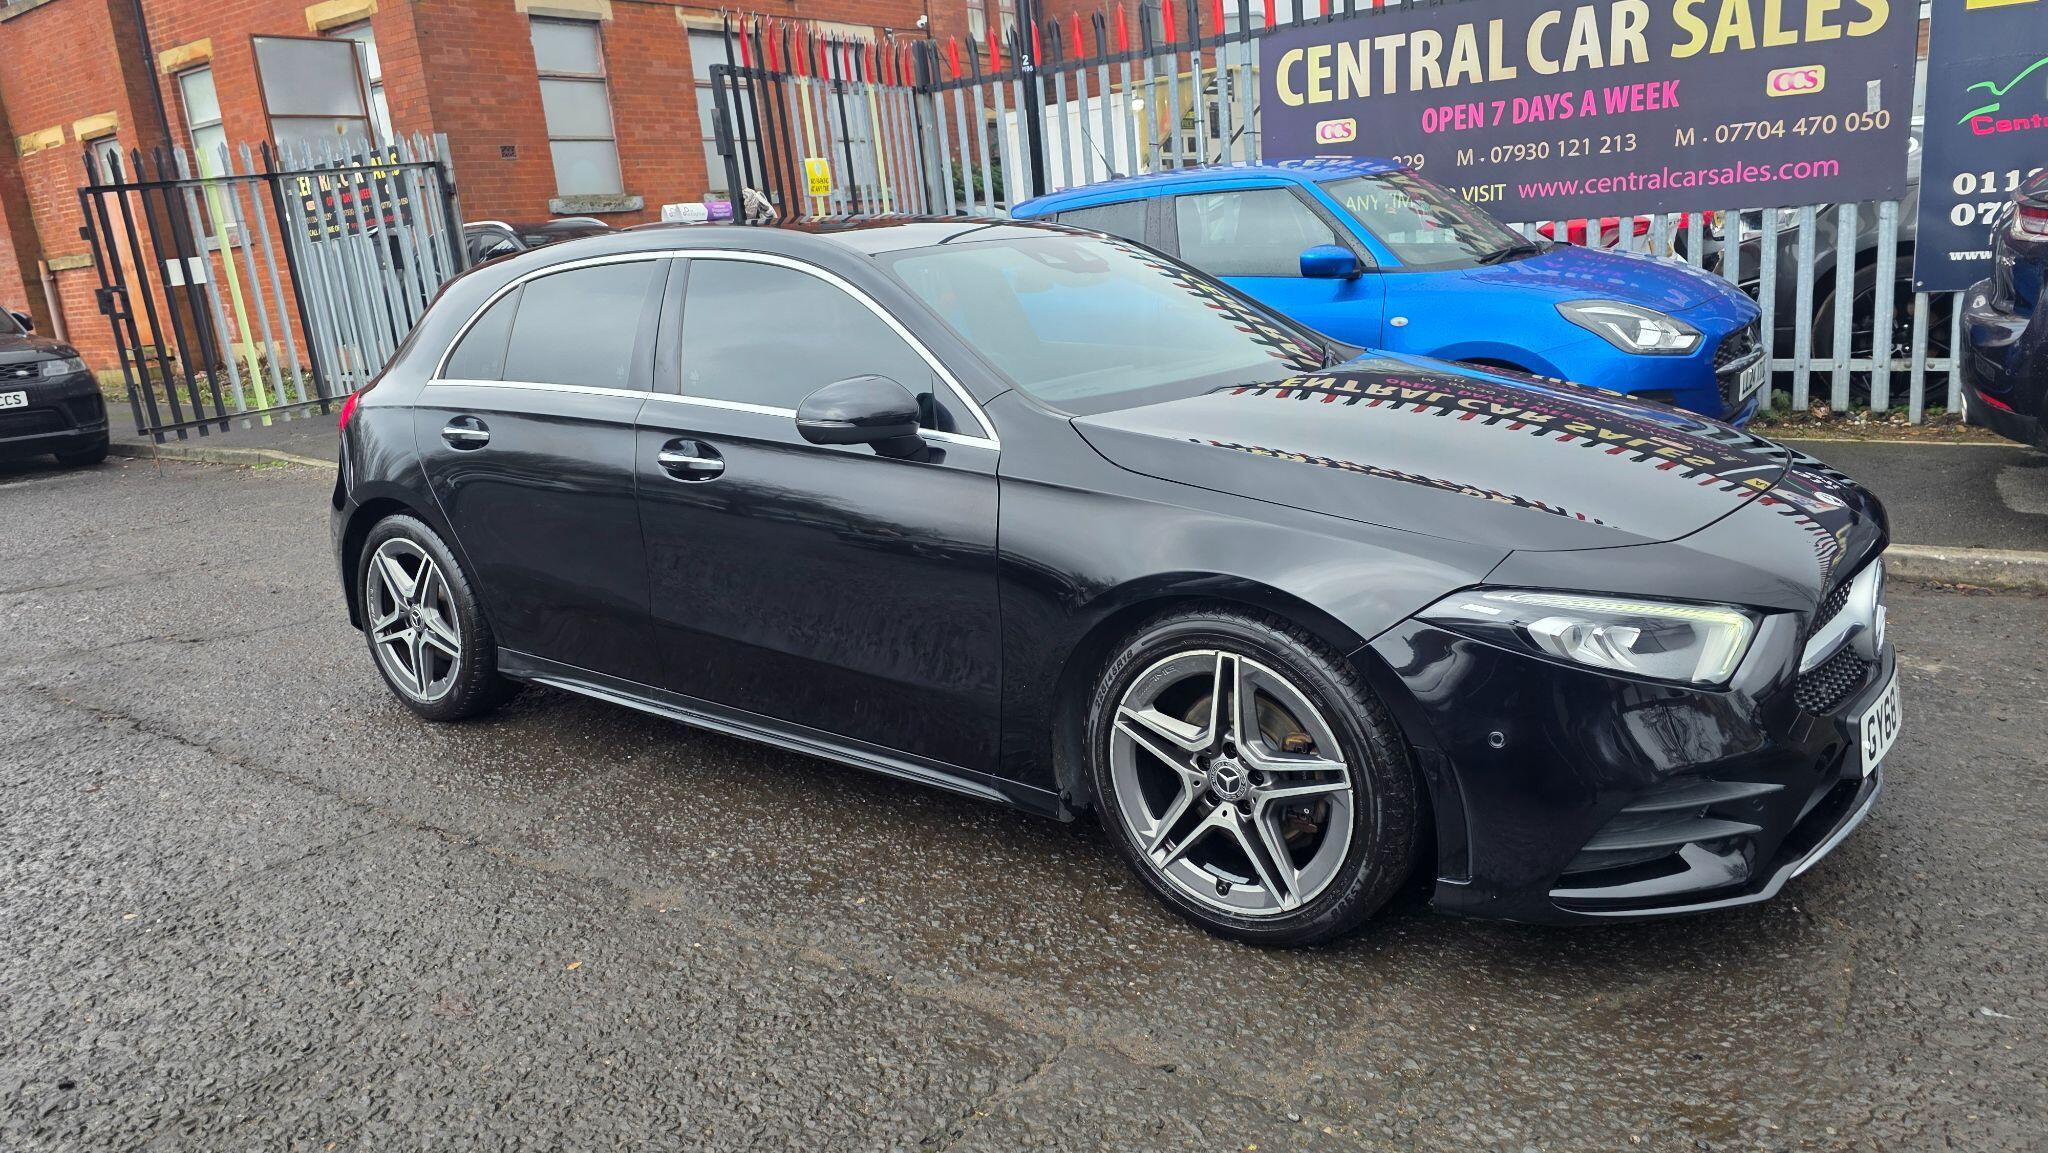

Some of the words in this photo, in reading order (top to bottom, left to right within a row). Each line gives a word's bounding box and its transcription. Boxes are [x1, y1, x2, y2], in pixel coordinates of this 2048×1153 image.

[1276, 19, 1517, 107] CENTRAL
[1526, 0, 1649, 75] CAR
[1670, 0, 1890, 58] SALES
[1773, 69, 1819, 92] CCS
[1422, 102, 1484, 134] OPEN
[1491, 100, 1506, 127] 7
[1512, 91, 1574, 125] DAYS
[1580, 89, 1597, 118] A
[1603, 79, 1681, 115] WEEK
[1715, 119, 1786, 144] 07704
[1792, 114, 1837, 137] 470
[1844, 109, 1891, 133] 050
[1320, 122, 1352, 140] CCS
[1490, 141, 1550, 164] 07930
[1558, 138, 1590, 158] 121
[1599, 133, 1637, 154] 213
[1346, 194, 1378, 211] ANY
[1461, 183, 1507, 203] VISIT
[1518, 159, 1839, 199] www.centralcarsales.com
[1867, 687, 1897, 761] GY68
